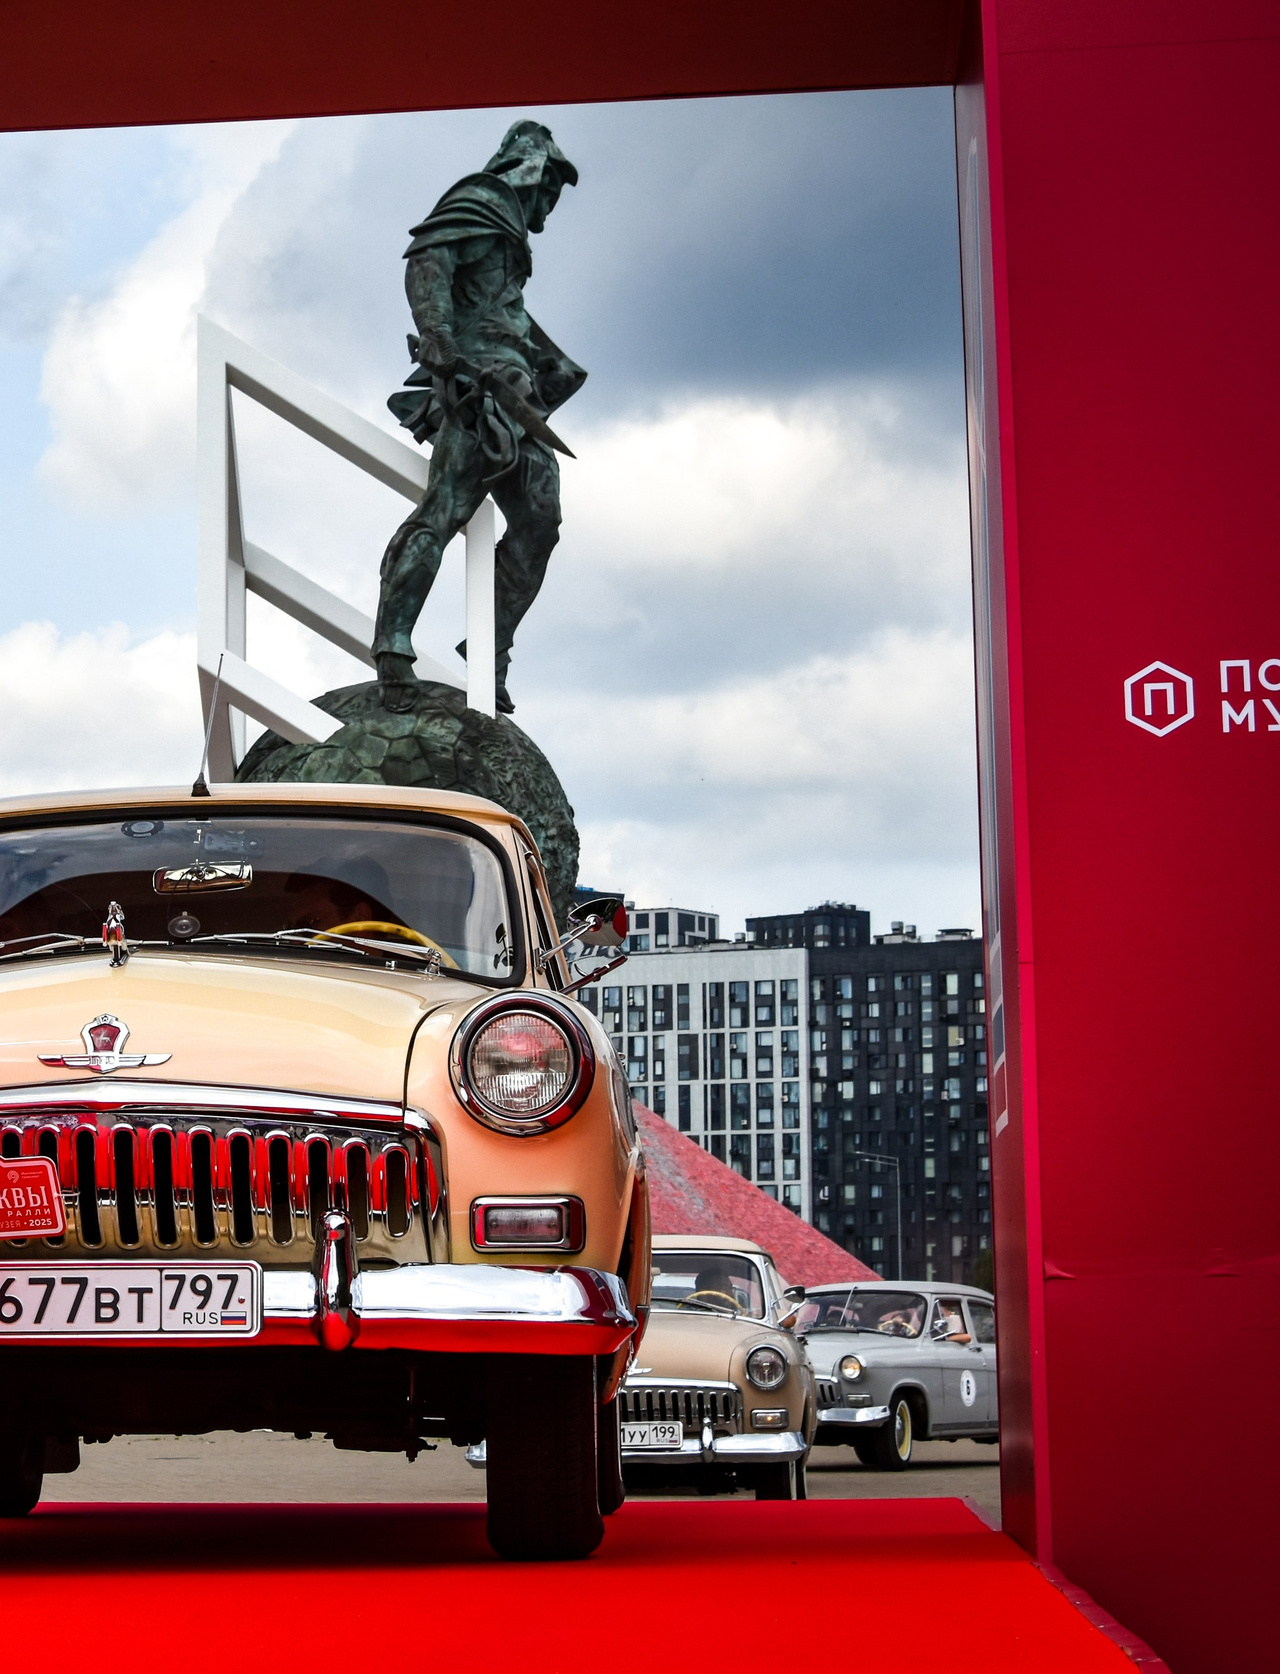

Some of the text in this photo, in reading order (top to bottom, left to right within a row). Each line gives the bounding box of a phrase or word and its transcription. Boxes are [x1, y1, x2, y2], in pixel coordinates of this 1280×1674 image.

[1220, 658, 1280, 693] ПО
[1143, 682, 1175, 716] П
[7, 1208, 51, 1218] РАЛЛИ
[29, 1217, 52, 1227] 2025
[164, 1273, 239, 1310] 797
[182, 1311, 219, 1325] RUS
[966, 1379, 971, 1396] 6
[651, 1426, 675, 1438] 199
